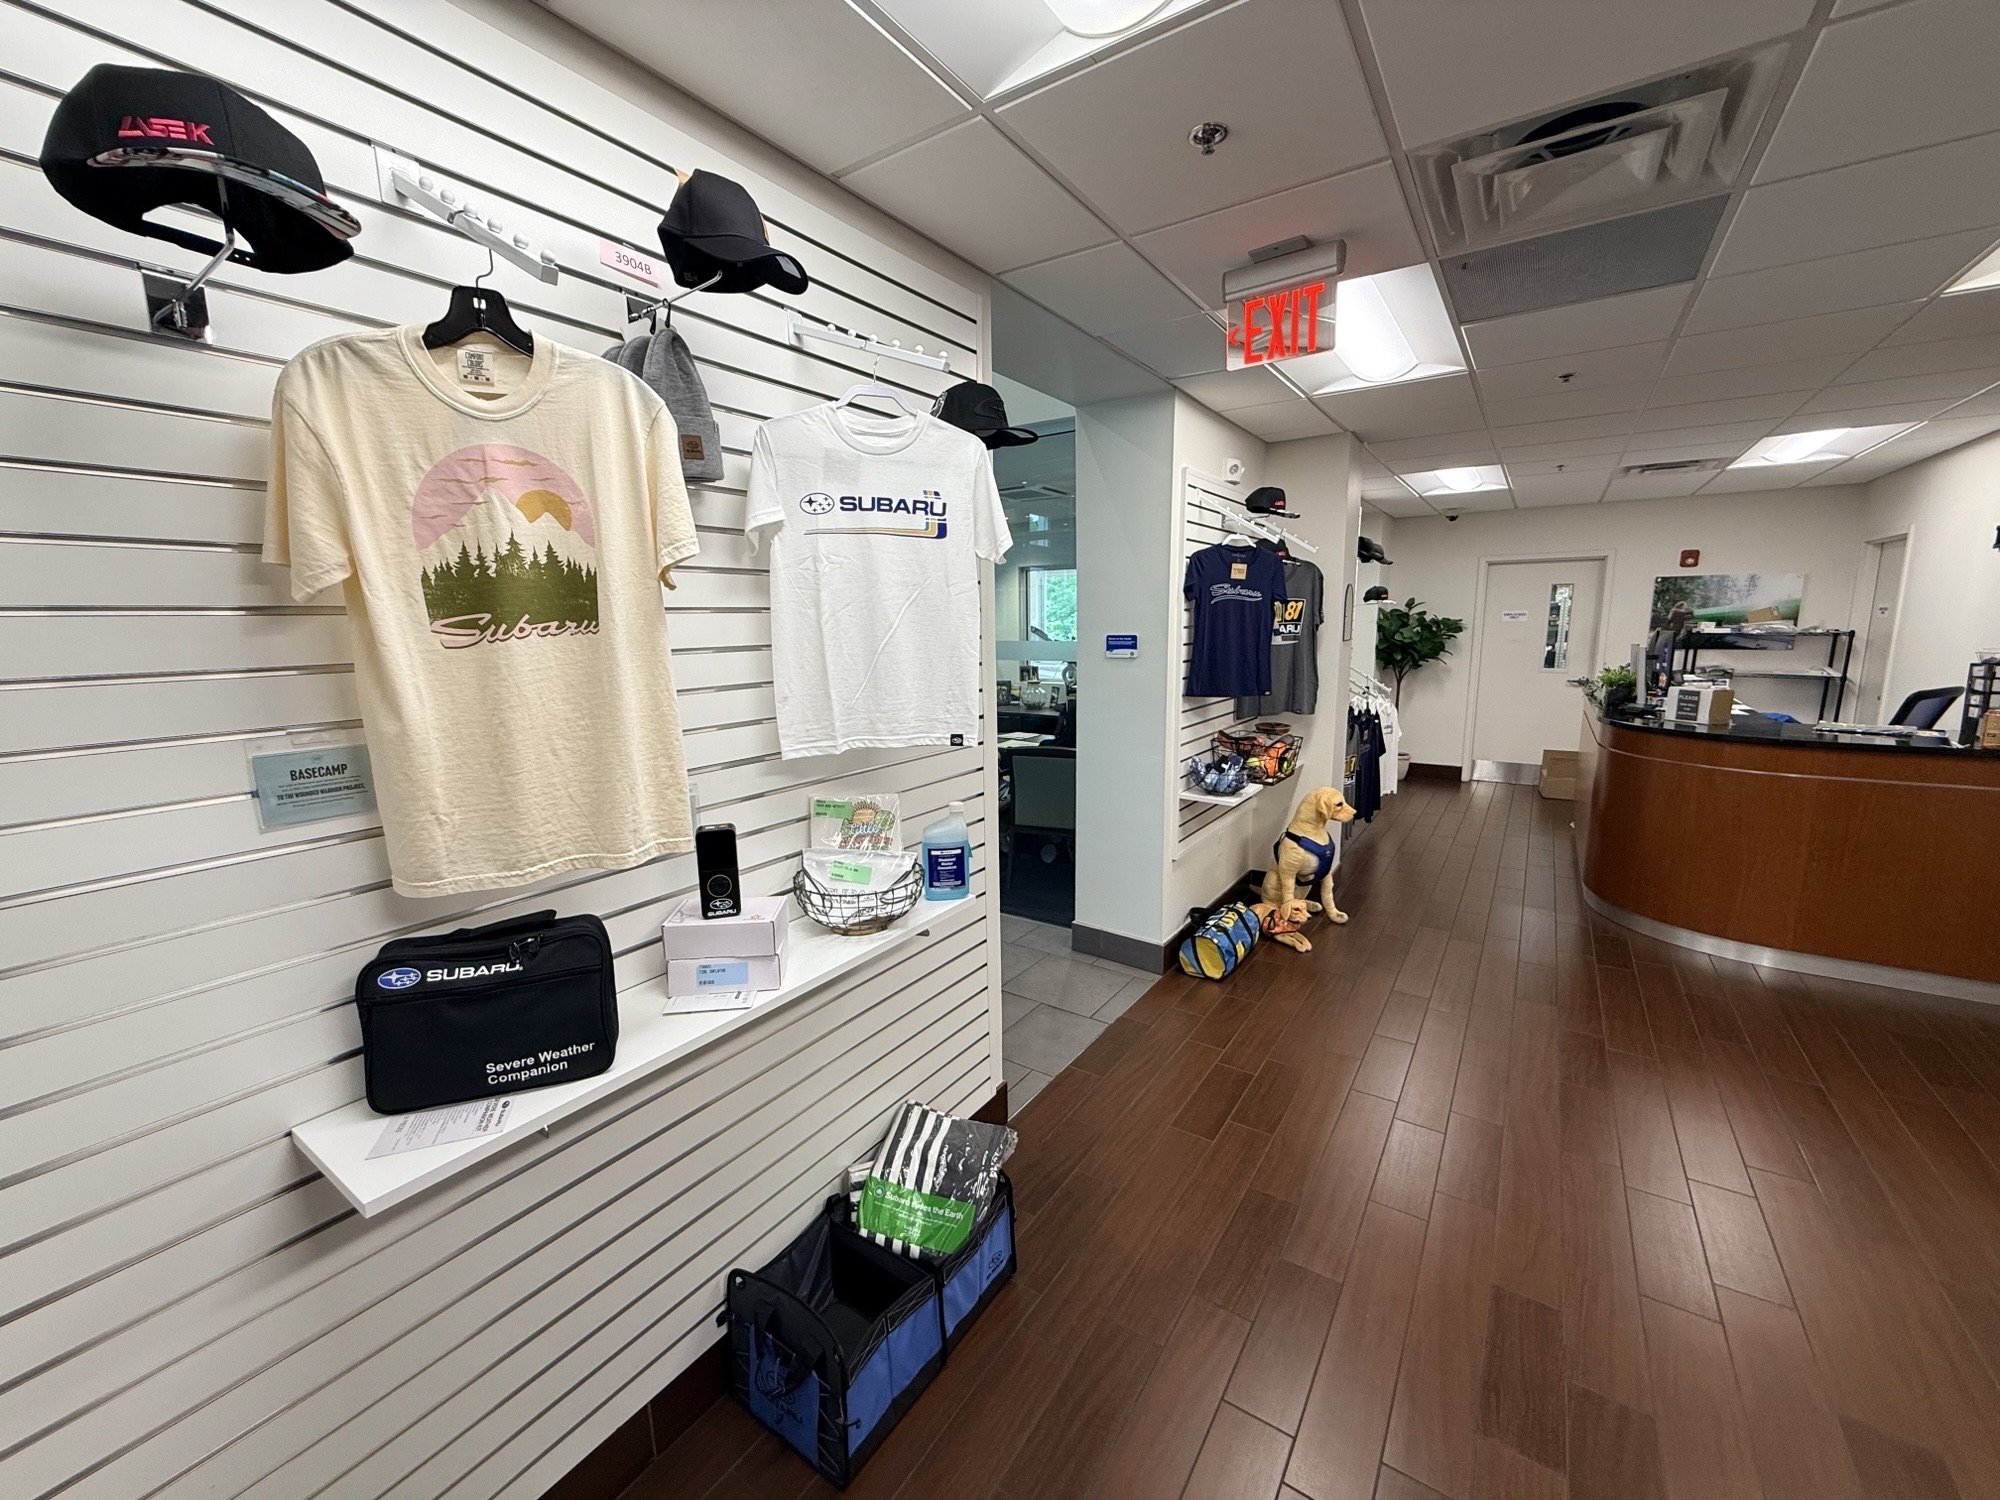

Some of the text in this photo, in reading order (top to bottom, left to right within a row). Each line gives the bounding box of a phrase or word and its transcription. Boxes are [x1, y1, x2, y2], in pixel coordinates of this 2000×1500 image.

[615, 251, 652, 275] 3904B
[1243, 282, 1325, 365] EXIT
[839, 495, 947, 517] SUBARU
[1285, 601, 1304, 621] 81
[430, 612, 600, 650] Subaru
[1279, 624, 1300, 634] ARU
[290, 763, 348, 781] BASECAMP
[295, 789, 320, 798] WOUNDED
[707, 908, 738, 917] SUBARU
[426, 960, 520, 982] SUBARU
[486, 1042, 595, 1074] Severe Weather
[487, 1061, 568, 1085] Companion
[885, 1190, 911, 1207] Subaru
[932, 1206, 944, 1216] the
[944, 1208, 964, 1221] Earth
